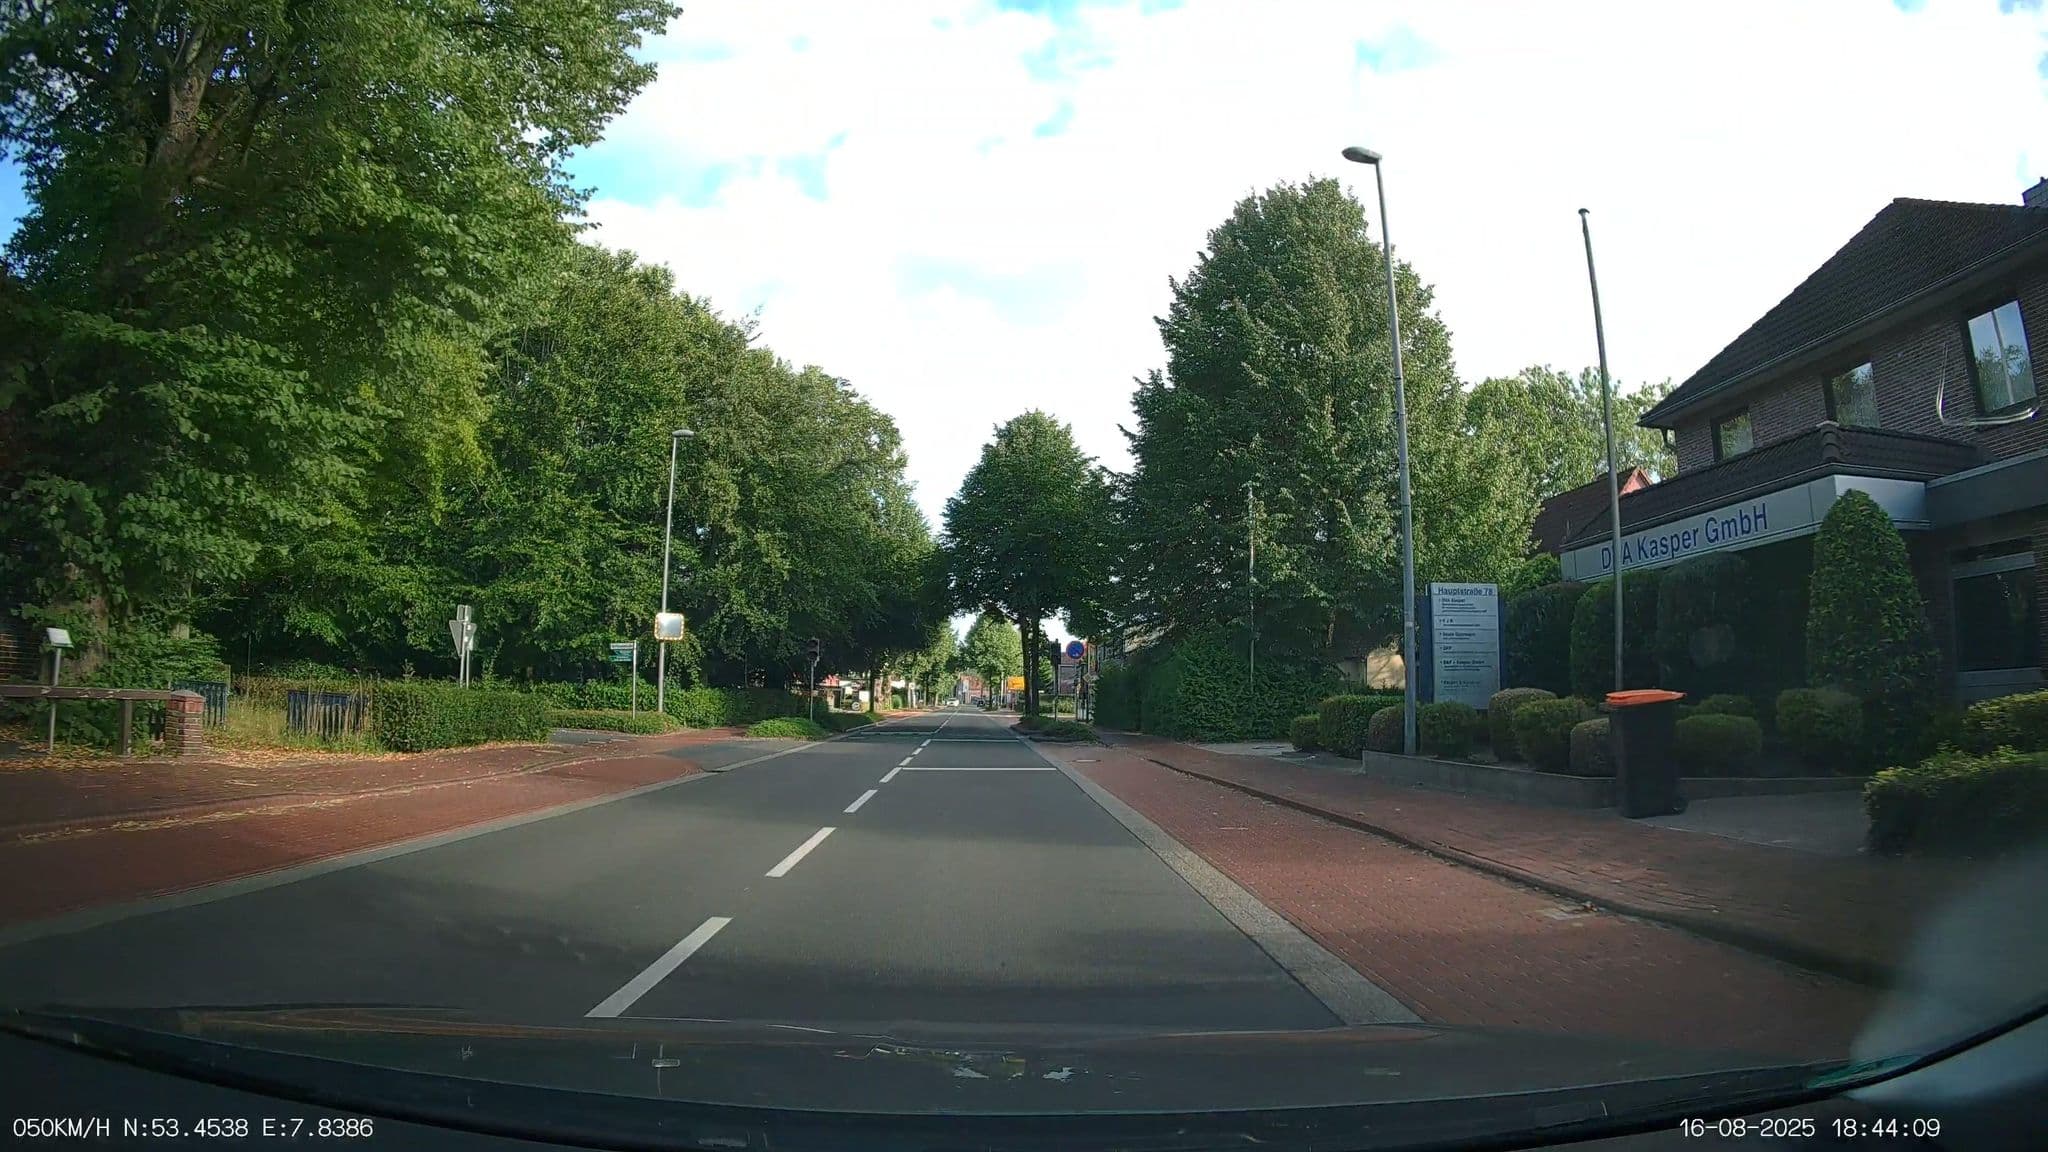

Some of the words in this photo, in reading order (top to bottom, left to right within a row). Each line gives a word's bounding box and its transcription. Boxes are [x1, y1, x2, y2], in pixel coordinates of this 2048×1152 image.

[1601, 542, 1633, 570] DA
[1637, 527, 1699, 561] Kasper
[1705, 503, 1768, 546] GmbH
[1438, 587, 1482, 596] Hauptstraße
